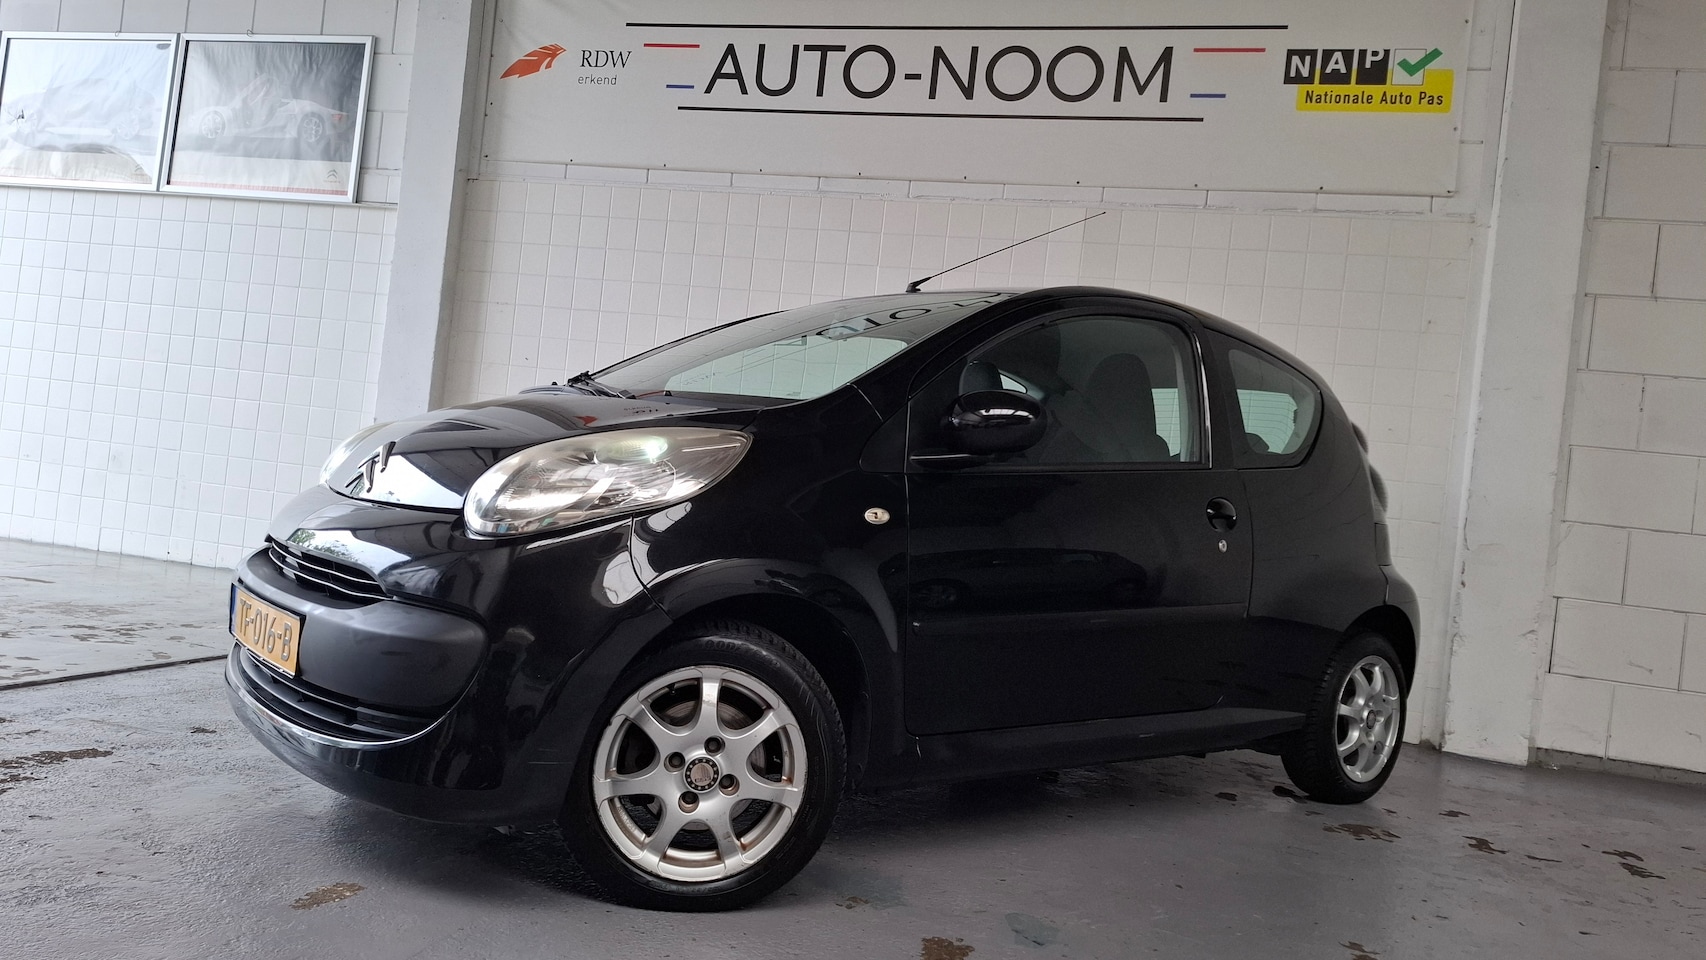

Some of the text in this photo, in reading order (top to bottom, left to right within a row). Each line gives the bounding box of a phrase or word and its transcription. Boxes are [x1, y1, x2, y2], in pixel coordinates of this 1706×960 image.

[579, 50, 632, 69] RDW
[1289, 48, 1385, 78] NAP
[577, 74, 618, 86] erkend
[703, 43, 1174, 103] AUTO-NOOM
[1304, 90, 1444, 105] Nationale Auto Pas
[240, 597, 293, 662] TF-016-B
